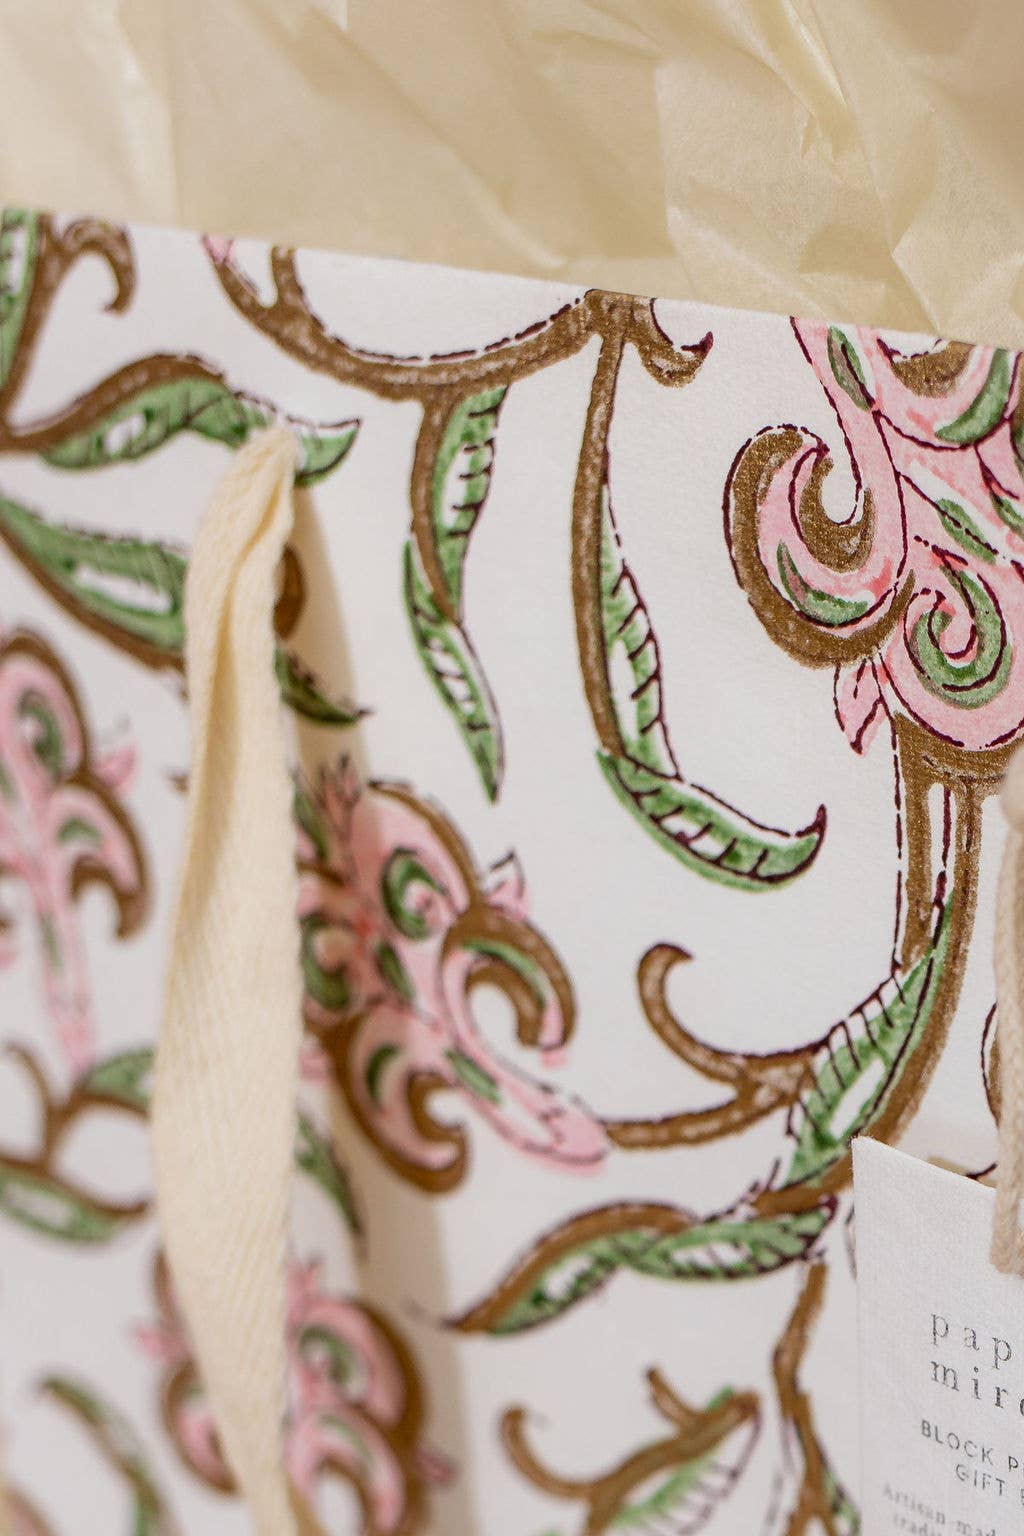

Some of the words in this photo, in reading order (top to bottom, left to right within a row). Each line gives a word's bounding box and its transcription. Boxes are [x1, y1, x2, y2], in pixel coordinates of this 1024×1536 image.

[920, 1417, 994, 1467] BLOCK
[955, 1463, 1006, 1497] GIFT
[883, 1482, 946, 1525] Artisan
